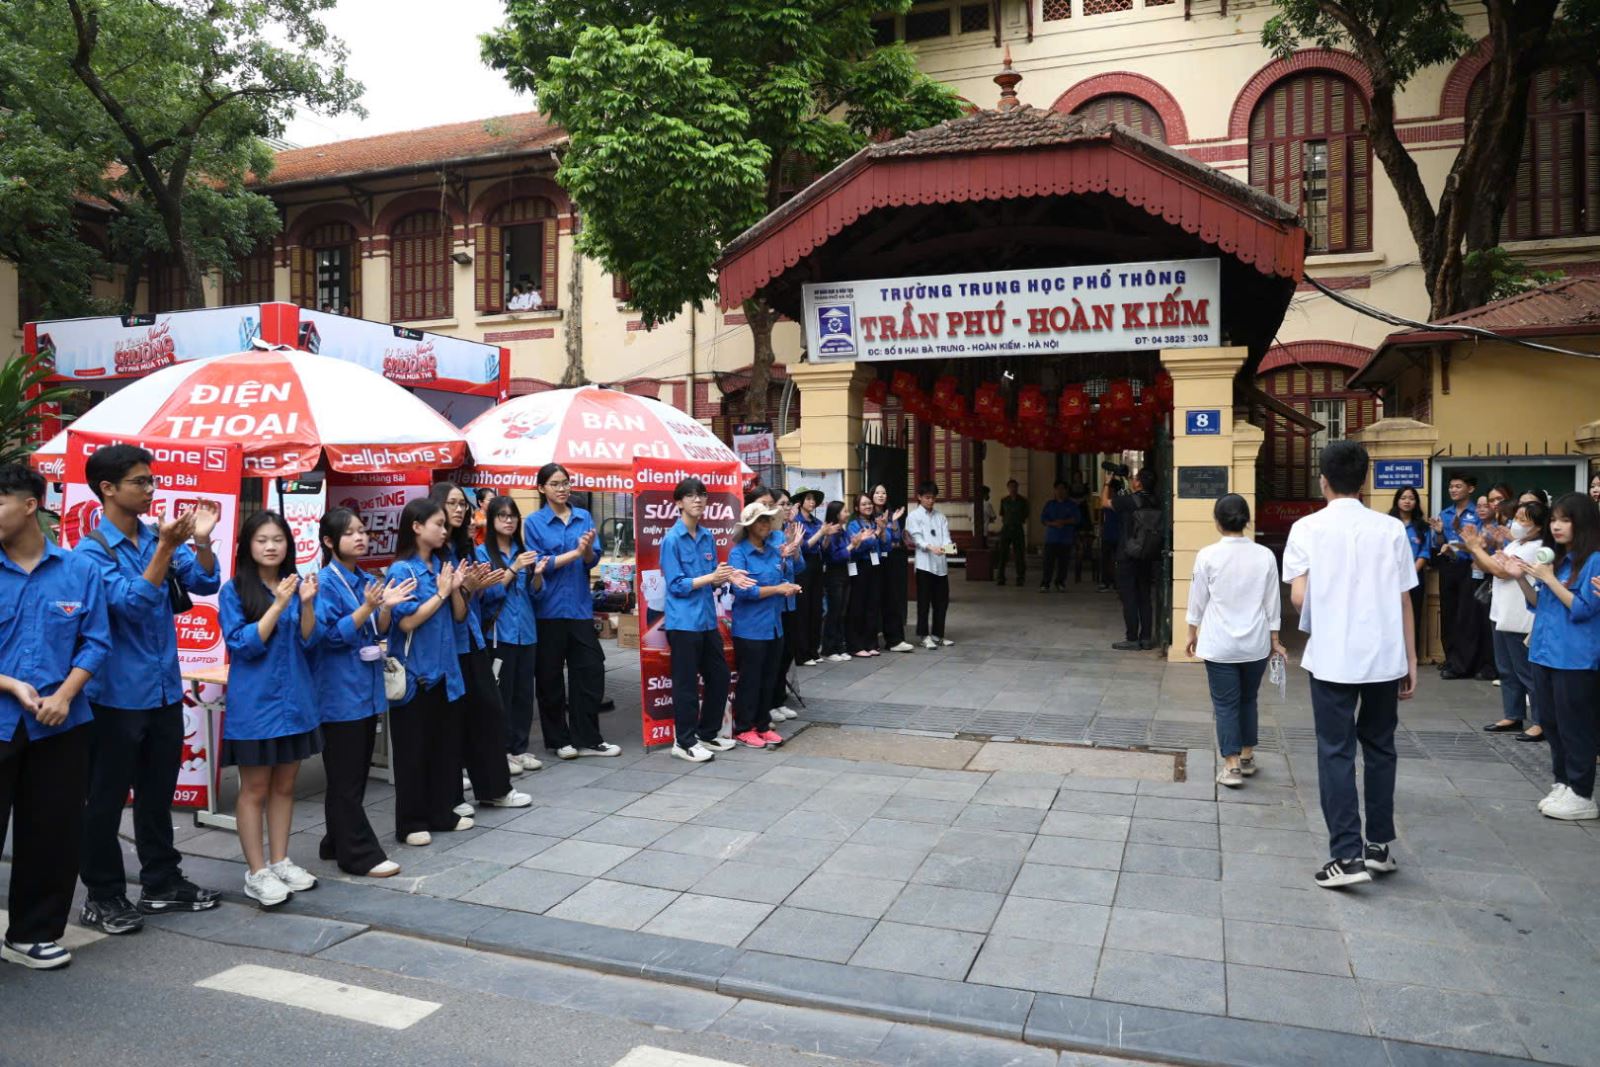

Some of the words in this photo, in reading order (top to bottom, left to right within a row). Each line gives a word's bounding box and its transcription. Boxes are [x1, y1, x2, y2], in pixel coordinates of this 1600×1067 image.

[880, 283, 953, 302] TRƯỜNG
[959, 280, 1020, 298] TRUNG
[1028, 277, 1065, 295] HỌC
[1073, 269, 1112, 290] PHỔ
[1119, 269, 1186, 288] THÔNG
[860, 302, 939, 342] TRẦN
[946, 300, 1006, 337] PHÚ
[1027, 297, 1115, 334] HOÀN
[1122, 286, 1210, 329] KIẾM
[1152, 336, 1162, 344] 04
[1164, 335, 1185, 343] 3825
[884, 345, 896, 355] SỐ
[905, 346, 919, 354] HAI
[922, 345, 933, 353] BÀ
[936, 344, 965, 353] TRƯNG
[972, 342, 997, 351] HOÀN
[1000, 340, 1020, 350] KIẾM
[1028, 340, 1041, 349] HÀ
[1043, 340, 1059, 349] NỘI
[189, 380, 292, 408] ĐIỆN
[166, 412, 298, 440] THOẠI
[582, 410, 646, 432] BÁN
[1196, 413, 1209, 427] 8
[568, 438, 625, 460] MÁY
[633, 440, 670, 459] CŨ
[176, 474, 198, 487] Bài
[393, 472, 406, 482] Bài
[570, 471, 634, 489] dientho
[376, 490, 405, 507] TÙNG
[644, 499, 681, 519] SỬA
[703, 503, 735, 520] HỮA
[360, 511, 400, 531] DEA
[716, 538, 728, 546] CŨ
[180, 627, 215, 643] Triệu
[186, 656, 218, 664] LAPTOP
[647, 675, 673, 690] Sửa
[654, 694, 673, 707] SỬA
[652, 725, 671, 739] 274
[173, 789, 198, 801] 097
